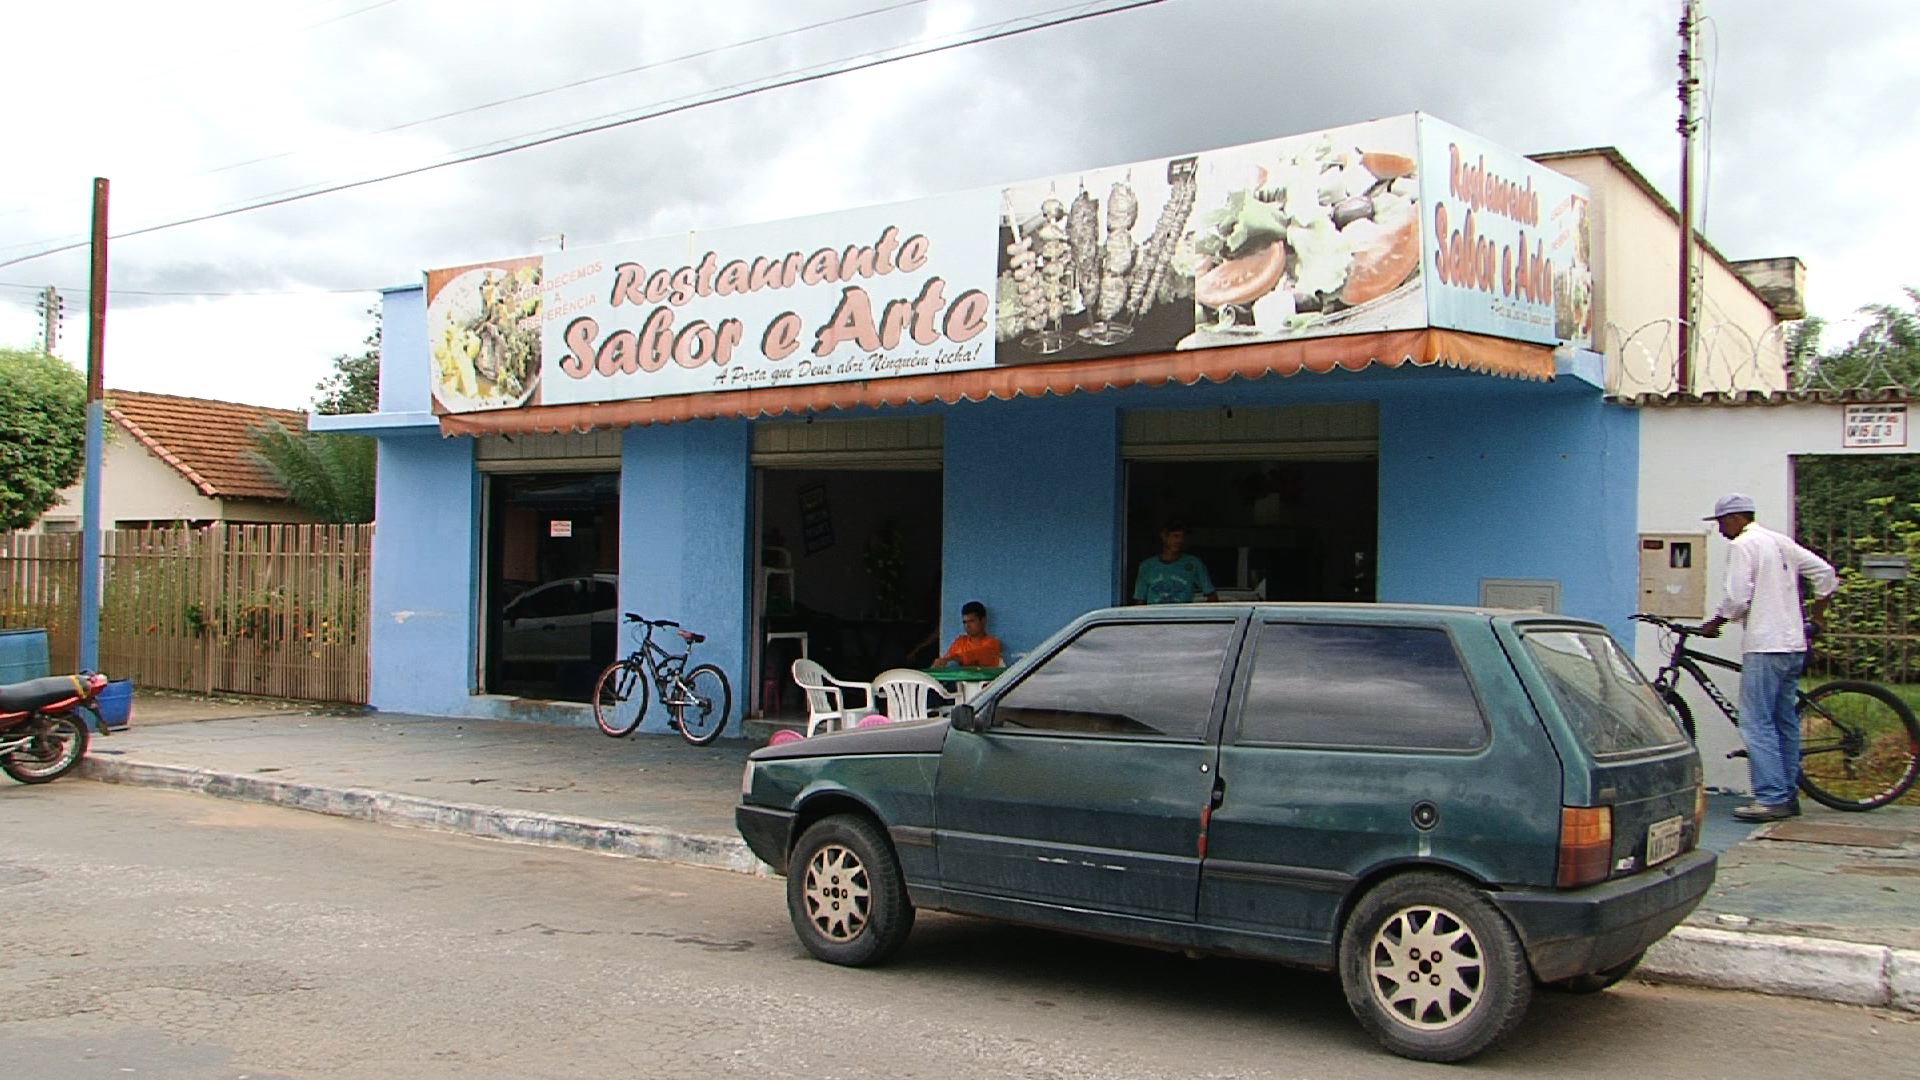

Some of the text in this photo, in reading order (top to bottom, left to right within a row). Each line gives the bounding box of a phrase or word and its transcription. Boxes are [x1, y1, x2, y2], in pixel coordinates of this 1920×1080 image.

[610, 225, 930, 307] Restaurante
[1435, 201, 1496, 295] Sabor
[559, 276, 989, 379] Sabor e Arte
[713, 367, 728, 385] A
[731, 366, 767, 384] Porta
[771, 367, 794, 385] que
[799, 360, 832, 378] Deus
[837, 355, 864, 374] abri
[934, 342, 983, 371] fecha!
